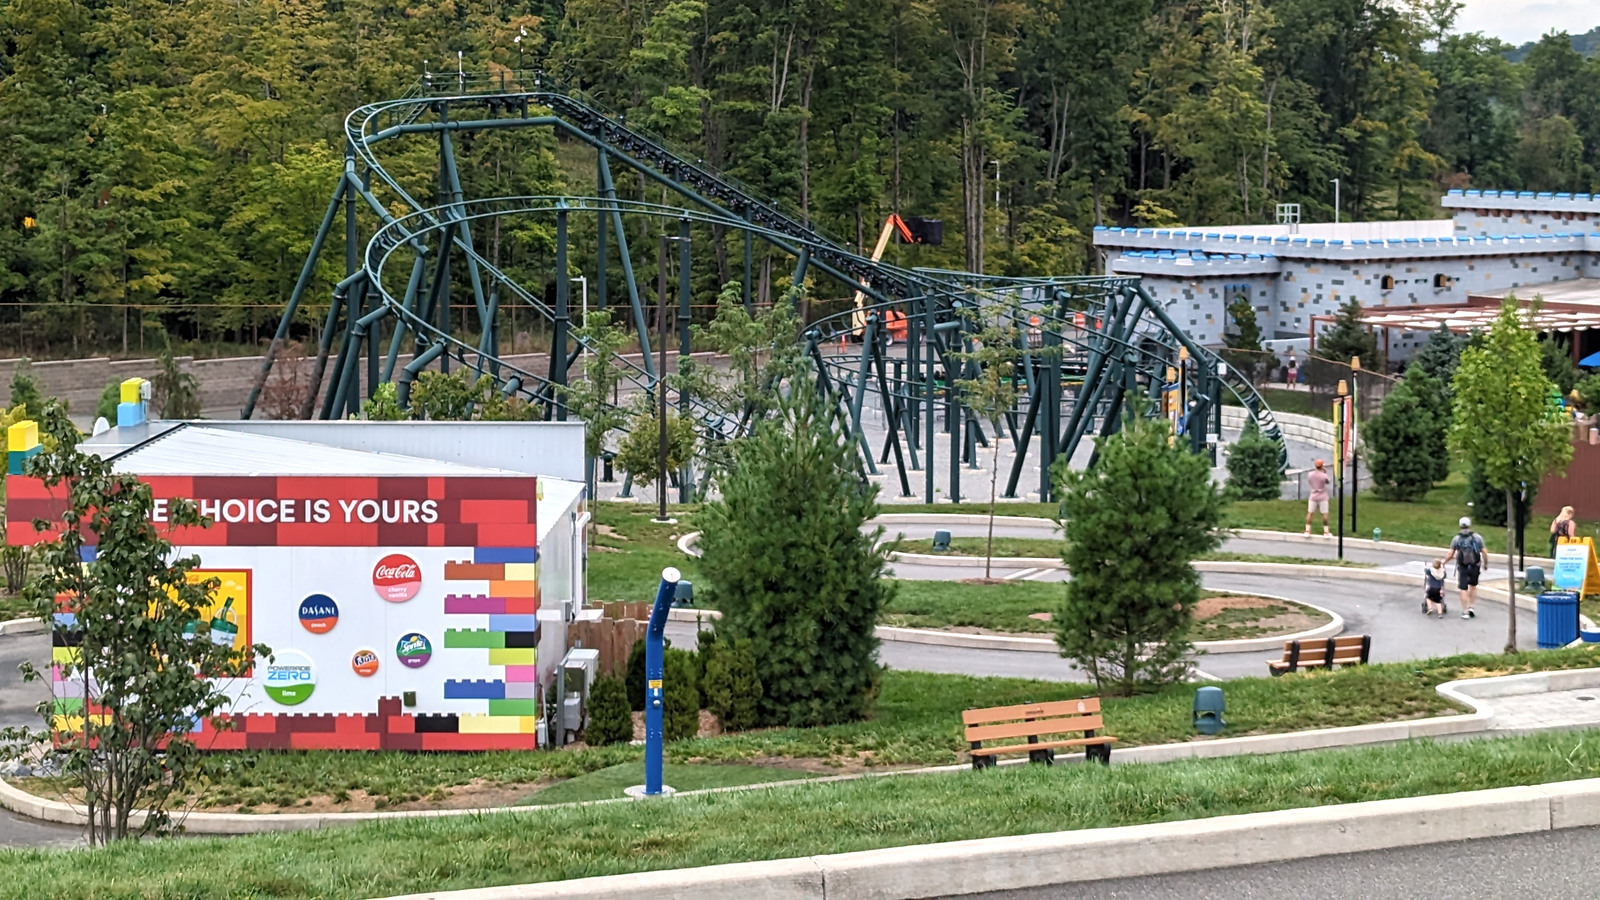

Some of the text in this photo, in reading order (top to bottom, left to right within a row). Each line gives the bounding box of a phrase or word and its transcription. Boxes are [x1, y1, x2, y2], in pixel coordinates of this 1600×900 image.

[177, 498, 295, 523] HOICE
[304, 498, 331, 523] IS
[337, 498, 438, 523] YOURS
[301, 604, 336, 616] DASANI
[267, 671, 311, 681] ZERO
